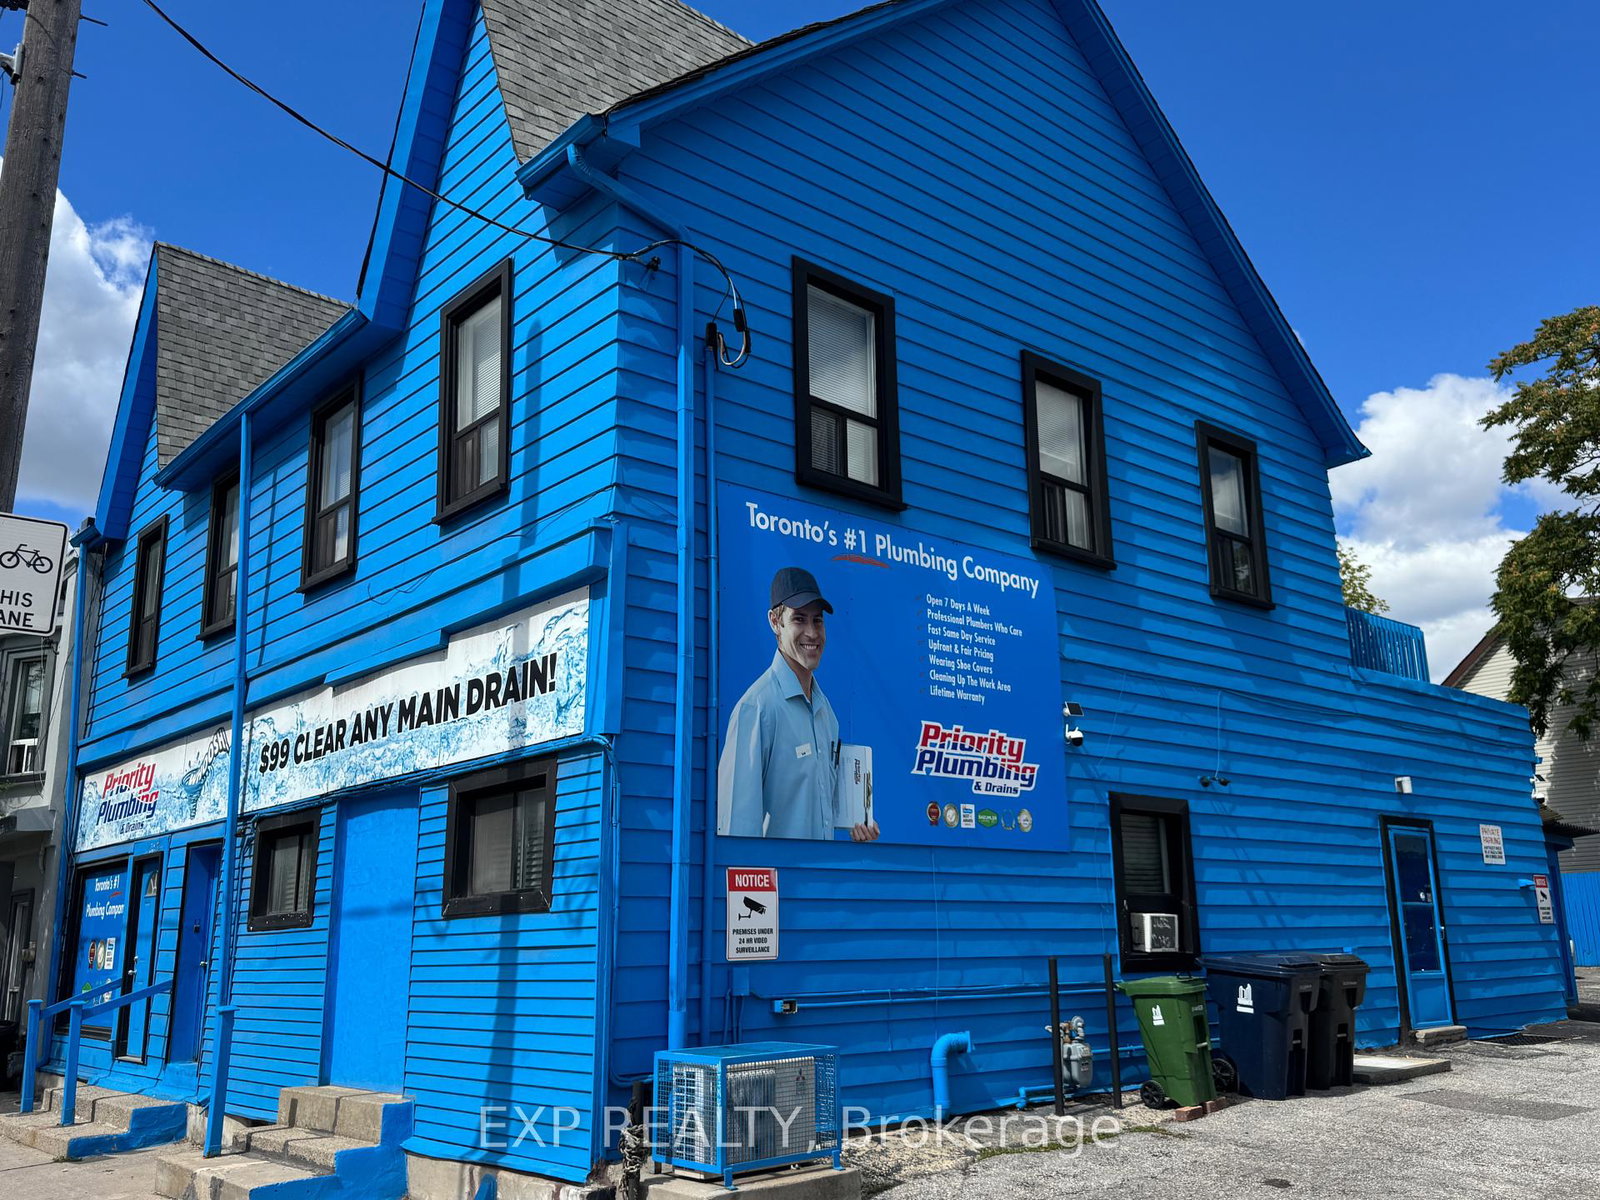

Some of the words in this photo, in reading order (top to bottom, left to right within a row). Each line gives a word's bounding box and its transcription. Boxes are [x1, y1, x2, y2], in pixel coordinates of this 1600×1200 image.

[746, 502, 838, 546] Toronto's
[844, 528, 867, 554] #1
[876, 535, 957, 581] Plumbing
[963, 556, 1039, 599] Company
[926, 593, 943, 607] Open
[944, 597, 949, 607] 7
[950, 599, 966, 613] Days
[967, 602, 972, 612] A
[973, 603, 991, 616] Week
[927, 608, 965, 626] Professional
[966, 615, 994, 631] Plumbers
[994, 622, 1009, 634] Who
[1009, 625, 1023, 637] Care
[927, 623, 942, 635] Fast
[943, 626, 960, 639] Same
[961, 630, 973, 644] Day
[974, 632, 996, 646] Service
[928, 639, 953, 653] Upfront
[954, 644, 960, 654] &
[960, 644, 972, 656] Fair
[973, 647, 994, 663] Pricing
[928, 654, 956, 671] Wearing
[956, 659, 971, 671] Shoe
[972, 662, 993, 674] Covers
[929, 669, 956, 687] Cleaning
[957, 674, 966, 688] Up
[967, 675, 978, 687] The
[979, 677, 996, 690] Work
[997, 680, 1012, 692] Area
[929, 685, 955, 699] Lifetime
[956, 689, 986, 706] Warranty
[259, 738, 291, 777] $99
[293, 718, 346, 766] CLEAR
[349, 702, 394, 748] ANY
[397, 682, 461, 734] MAIN
[465, 652, 558, 717] DRAIN!
[919, 721, 1025, 763] Priority
[916, 748, 1036, 788] Plumbing
[102, 762, 156, 799] Priority
[974, 781, 982, 791] &
[985, 782, 1019, 795] Drains
[96, 790, 160, 826] Plumbing
[125, 820, 145, 834] Drains
[735, 874, 770, 887] NOTICE
[86, 901, 105, 920] Plumbing
[735, 946, 770, 954] SURVEILLANCE
